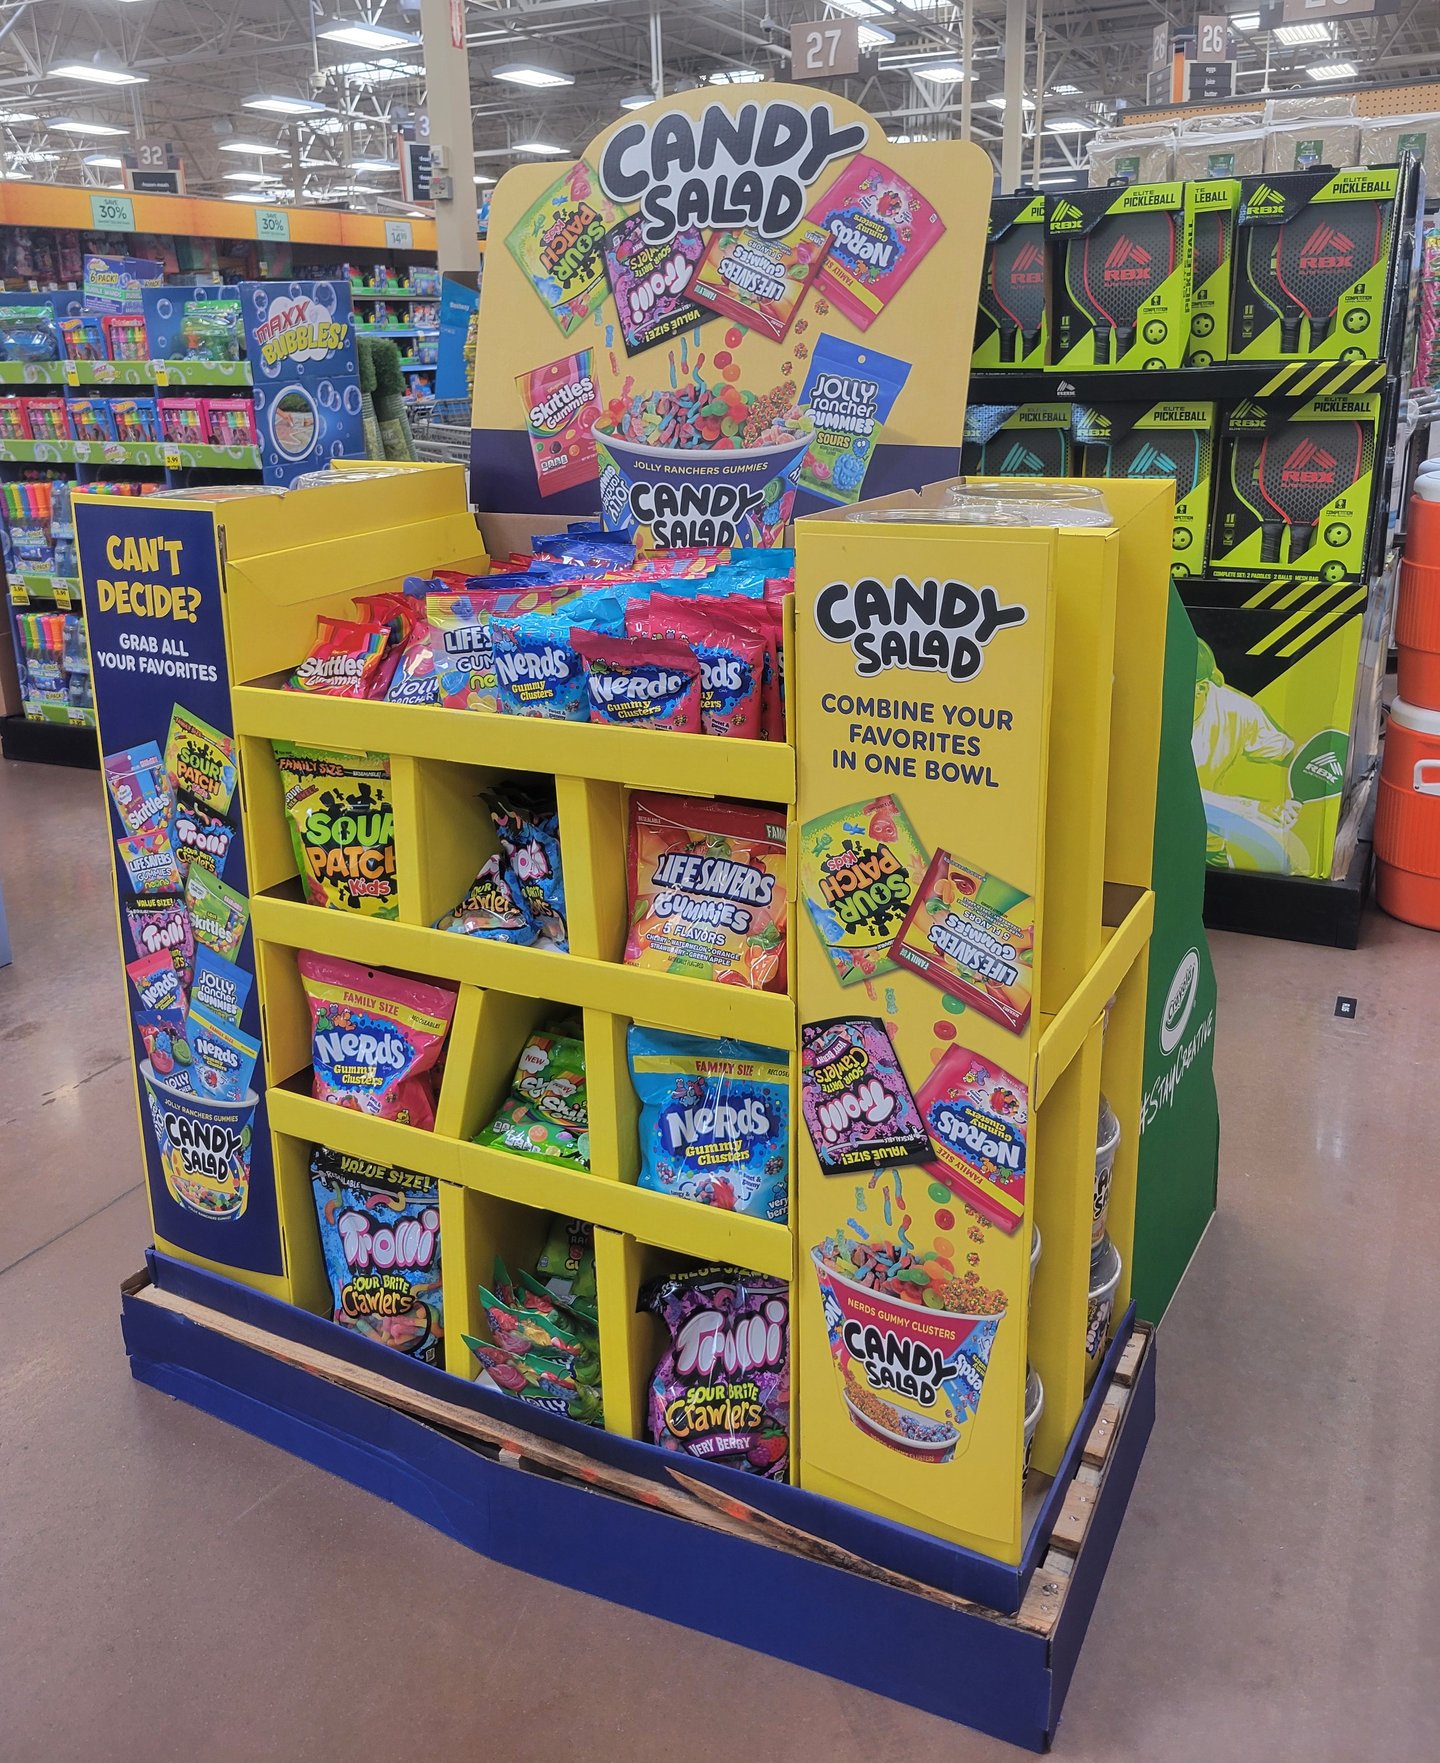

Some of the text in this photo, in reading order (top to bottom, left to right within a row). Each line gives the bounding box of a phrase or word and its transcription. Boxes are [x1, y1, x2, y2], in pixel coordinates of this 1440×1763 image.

[806, 29, 842, 69] 27
[1202, 24, 1224, 53] 26
[140, 145, 164, 166] 32
[602, 102, 866, 199] CANDY
[1123, 192, 1176, 208] PICKLEBALL
[1332, 181, 1392, 195] PICKLEBALL
[99, 206, 127, 220] 30%
[644, 170, 803, 241] SALAD
[1246, 205, 1285, 215] RBX
[262, 219, 284, 231] 30%
[540, 203, 597, 271] PATCH
[1049, 220, 1083, 231] RBX
[553, 221, 606, 282] SOUR
[1300, 256, 1353, 269] RBX
[831, 264, 854, 287] FAMILY
[1103, 268, 1151, 281] RBX
[630, 253, 694, 324] Trolli
[257, 300, 311, 346] MAXX
[645, 309, 701, 342] VALUE SIZE!
[261, 322, 348, 366] BUBBLES!
[529, 376, 595, 428] Skittles
[812, 376, 876, 404] JOLLY
[546, 390, 595, 430] Gummies
[812, 397, 875, 419] rancher
[1019, 411, 1068, 423] PICKLEBALL
[1152, 410, 1208, 422] PICKLEBALL
[1313, 402, 1372, 413] PICKLEBALL
[804, 408, 875, 436] GUMMIES
[1076, 428, 1111, 437] RBX
[1228, 418, 1268, 428] RBX
[817, 432, 851, 448] SOURS
[633, 461, 769, 475] JOLLY RANCHERS GUMMIES
[1281, 470, 1336, 483] RBX
[629, 484, 765, 523] CANDY
[652, 519, 736, 549] SALAD
[106, 534, 184, 576] CAN'T
[96, 579, 202, 624] DECIDE?
[815, 576, 1026, 644] CANDY
[119, 632, 190, 658] GRAB ALL
[853, 629, 982, 680] SALAD
[97, 651, 219, 683] YOUR FAVORITES
[296, 653, 366, 679] Skittles
[511, 680, 546, 694] Gummy
[519, 688, 554, 702] Clusters
[606, 700, 651, 713] Gummy
[617, 704, 662, 719] Clusters
[821, 693, 1014, 732] COMBINE YOUR
[849, 723, 982, 757] FAVORITES
[180, 747, 221, 780] SOUR
[278, 757, 318, 775] FAMILY
[318, 761, 344, 777] SIZE
[832, 749, 1000, 788] IN ONE BOWL
[1304, 762, 1340, 785] RBX
[177, 760, 222, 796] PATCH
[128, 793, 170, 830] Skittles
[176, 819, 229, 856] Trolli
[305, 846, 397, 880] PATCH
[826, 849, 858, 872] Kids
[349, 879, 391, 898] Kids
[819, 847, 903, 903] PATCH
[136, 897, 174, 908] VALUE SIZE!
[834, 873, 912, 925] SOUR
[142, 914, 185, 953] Trolli
[189, 912, 233, 943] Skittles
[662, 922, 726, 945] 5 FLAVORS
[963, 909, 1003, 936] FLAVORS
[1002, 931, 1011, 941] 5
[646, 933, 741, 961] CHERRY WATERMELON ORANGE
[649, 942, 732, 967] STRAWBERRY GREEN APPLE
[200, 971, 235, 995] JOLLY
[201, 984, 236, 1004] rancher
[197, 991, 238, 1014] GUMMIES
[342, 991, 400, 1017] FAMILY SIZE
[333, 1064, 378, 1077] Gummy
[524, 1053, 545, 1066] NEW
[694, 1060, 754, 1077] FAMILY SIZE
[814, 1047, 870, 1084] Crawlers
[341, 1074, 384, 1086] Clusters
[164, 1098, 239, 1123] JOLLY RANCHERS GUMMIES
[818, 1078, 895, 1143] Trolli
[164, 1113, 242, 1153] CANDY
[969, 1116, 1013, 1143] Gummy
[685, 1138, 743, 1156] Gummy
[697, 1149, 750, 1166] Clusters
[842, 1144, 909, 1166] VALUE SIZE!
[182, 1149, 229, 1182] SALAD
[340, 1156, 431, 1193] VALUE SIZE!
[935, 1146, 984, 1186] FAMILY SIZE
[338, 1209, 440, 1268] Trolli
[352, 1275, 381, 1293] SOUR
[341, 1285, 415, 1318] Crawlers
[847, 1297, 957, 1342] NERDS GUMMY CLUSTERS
[676, 1300, 787, 1374] Trolli
[843, 1322, 958, 1386] CANDY
[686, 1385, 727, 1404] SOUR
[865, 1360, 936, 1404] SALAD
[665, 1398, 763, 1438] Crawlers
[688, 1435, 751, 1458] VERY BERRY
